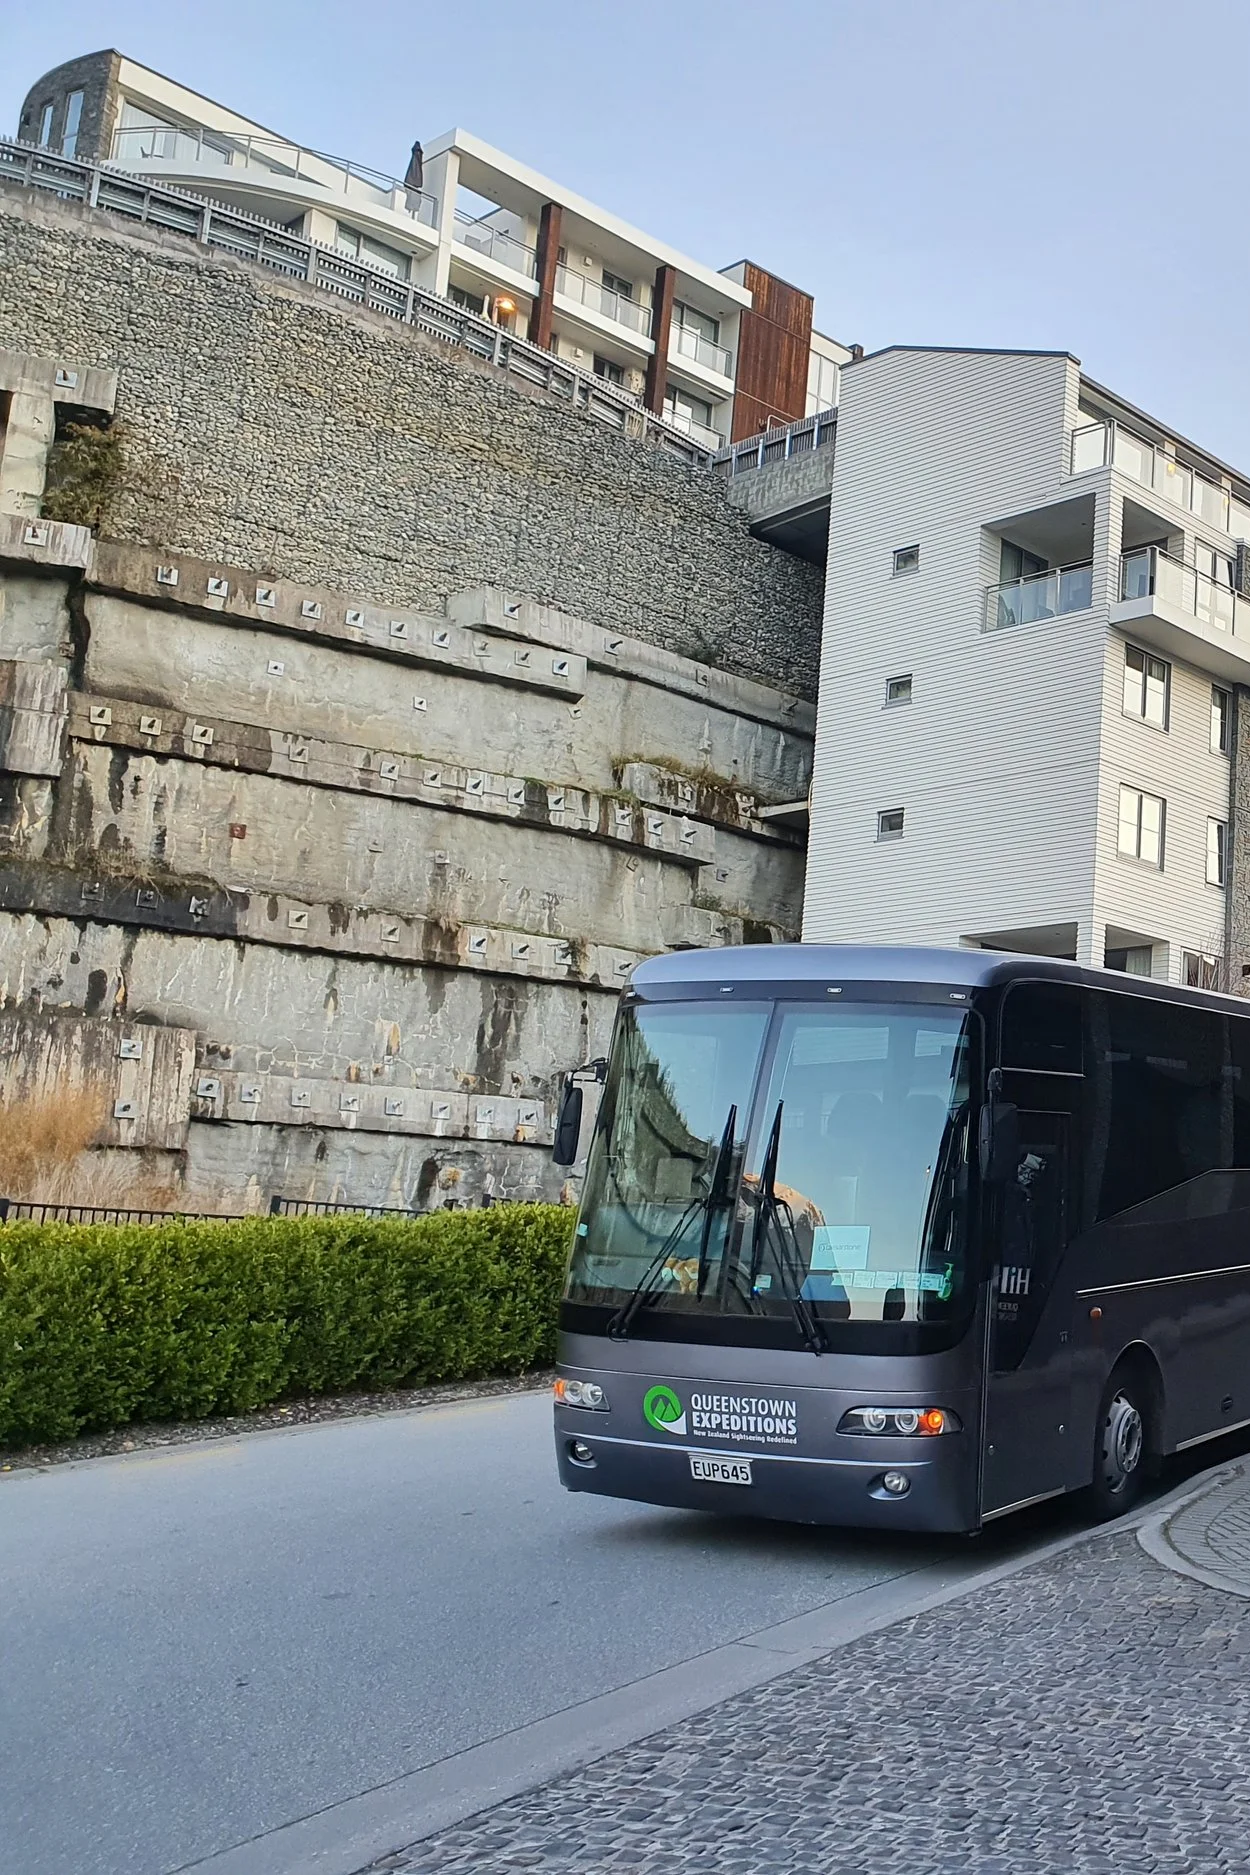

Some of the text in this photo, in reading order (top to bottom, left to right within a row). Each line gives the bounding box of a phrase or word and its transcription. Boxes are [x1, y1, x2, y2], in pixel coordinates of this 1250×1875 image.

[691, 1393, 797, 1418] QUEENSTOWN
[692, 1411, 797, 1435] EXPEDITIONS
[693, 1429, 797, 1445] New Zealand Sightseeing Redefined
[693, 1461, 749, 1481] EUP645
